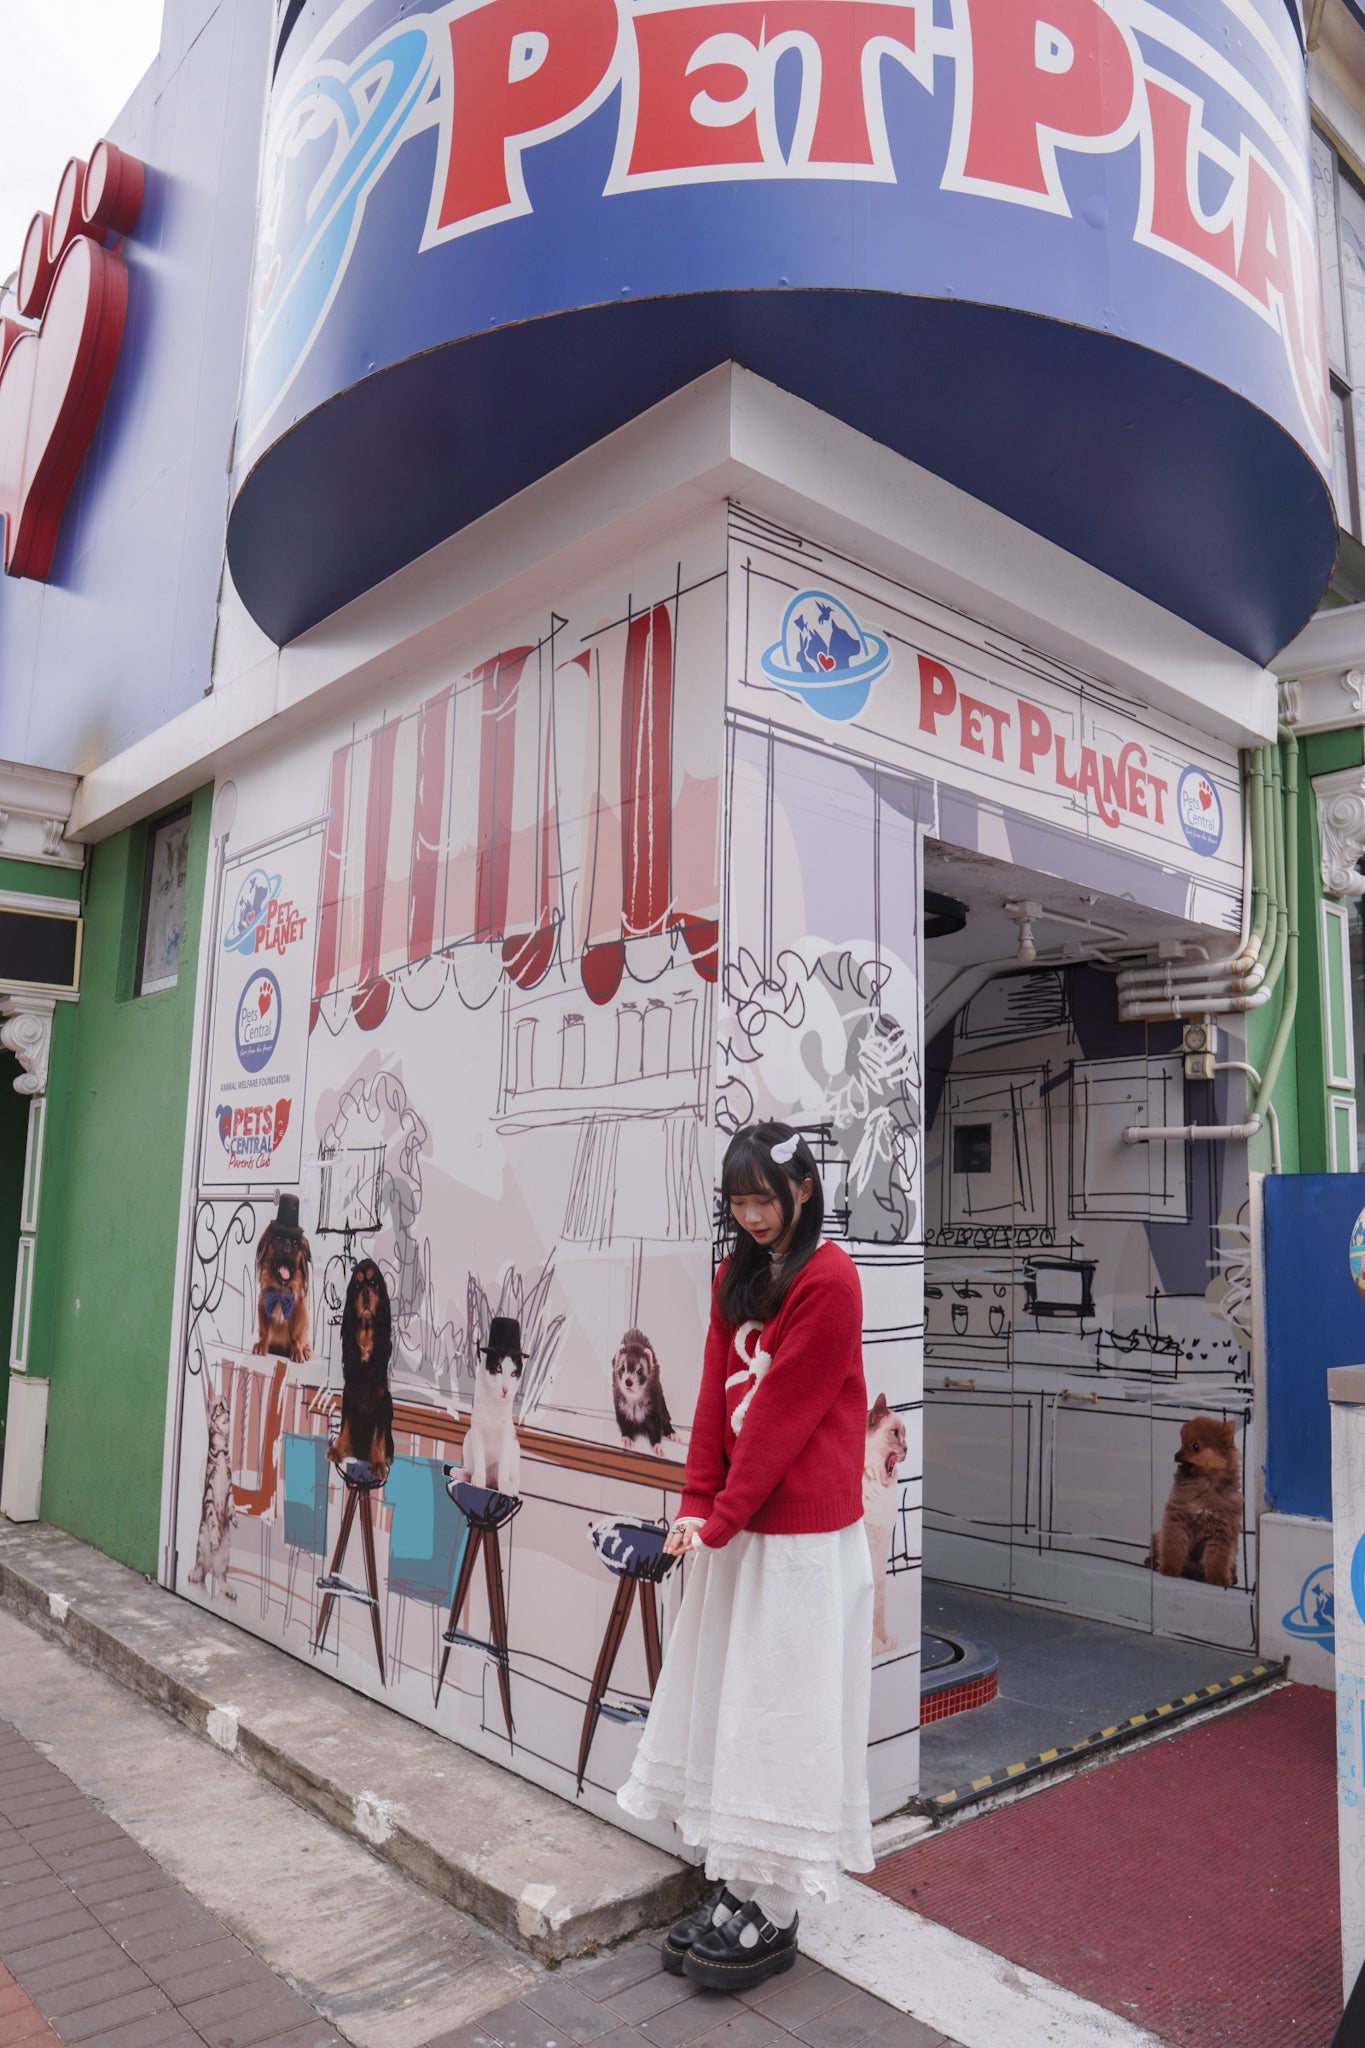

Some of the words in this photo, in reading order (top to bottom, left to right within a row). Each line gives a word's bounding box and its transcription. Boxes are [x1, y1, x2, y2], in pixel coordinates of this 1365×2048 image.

[436, 0, 916, 230] PET
[916, 653, 1011, 763] PET
[1016, 698, 1168, 829] PLANET
[1182, 789, 1200, 810] Pets
[1186, 807, 1215, 833] Central
[266, 898, 294, 929] PET
[254, 908, 307, 956] PLANET
[241, 1007, 258, 1027] Pets
[243, 1020, 272, 1043] Central
[219, 1081, 237, 1092] ANIMAL
[237, 1078, 258, 1089] WELFARE
[258, 1074, 291, 1087] FOUNDATION
[232, 1104, 274, 1137] PETS
[230, 1135, 272, 1155] CENTRAL
[255, 1151, 271, 1169] Club
